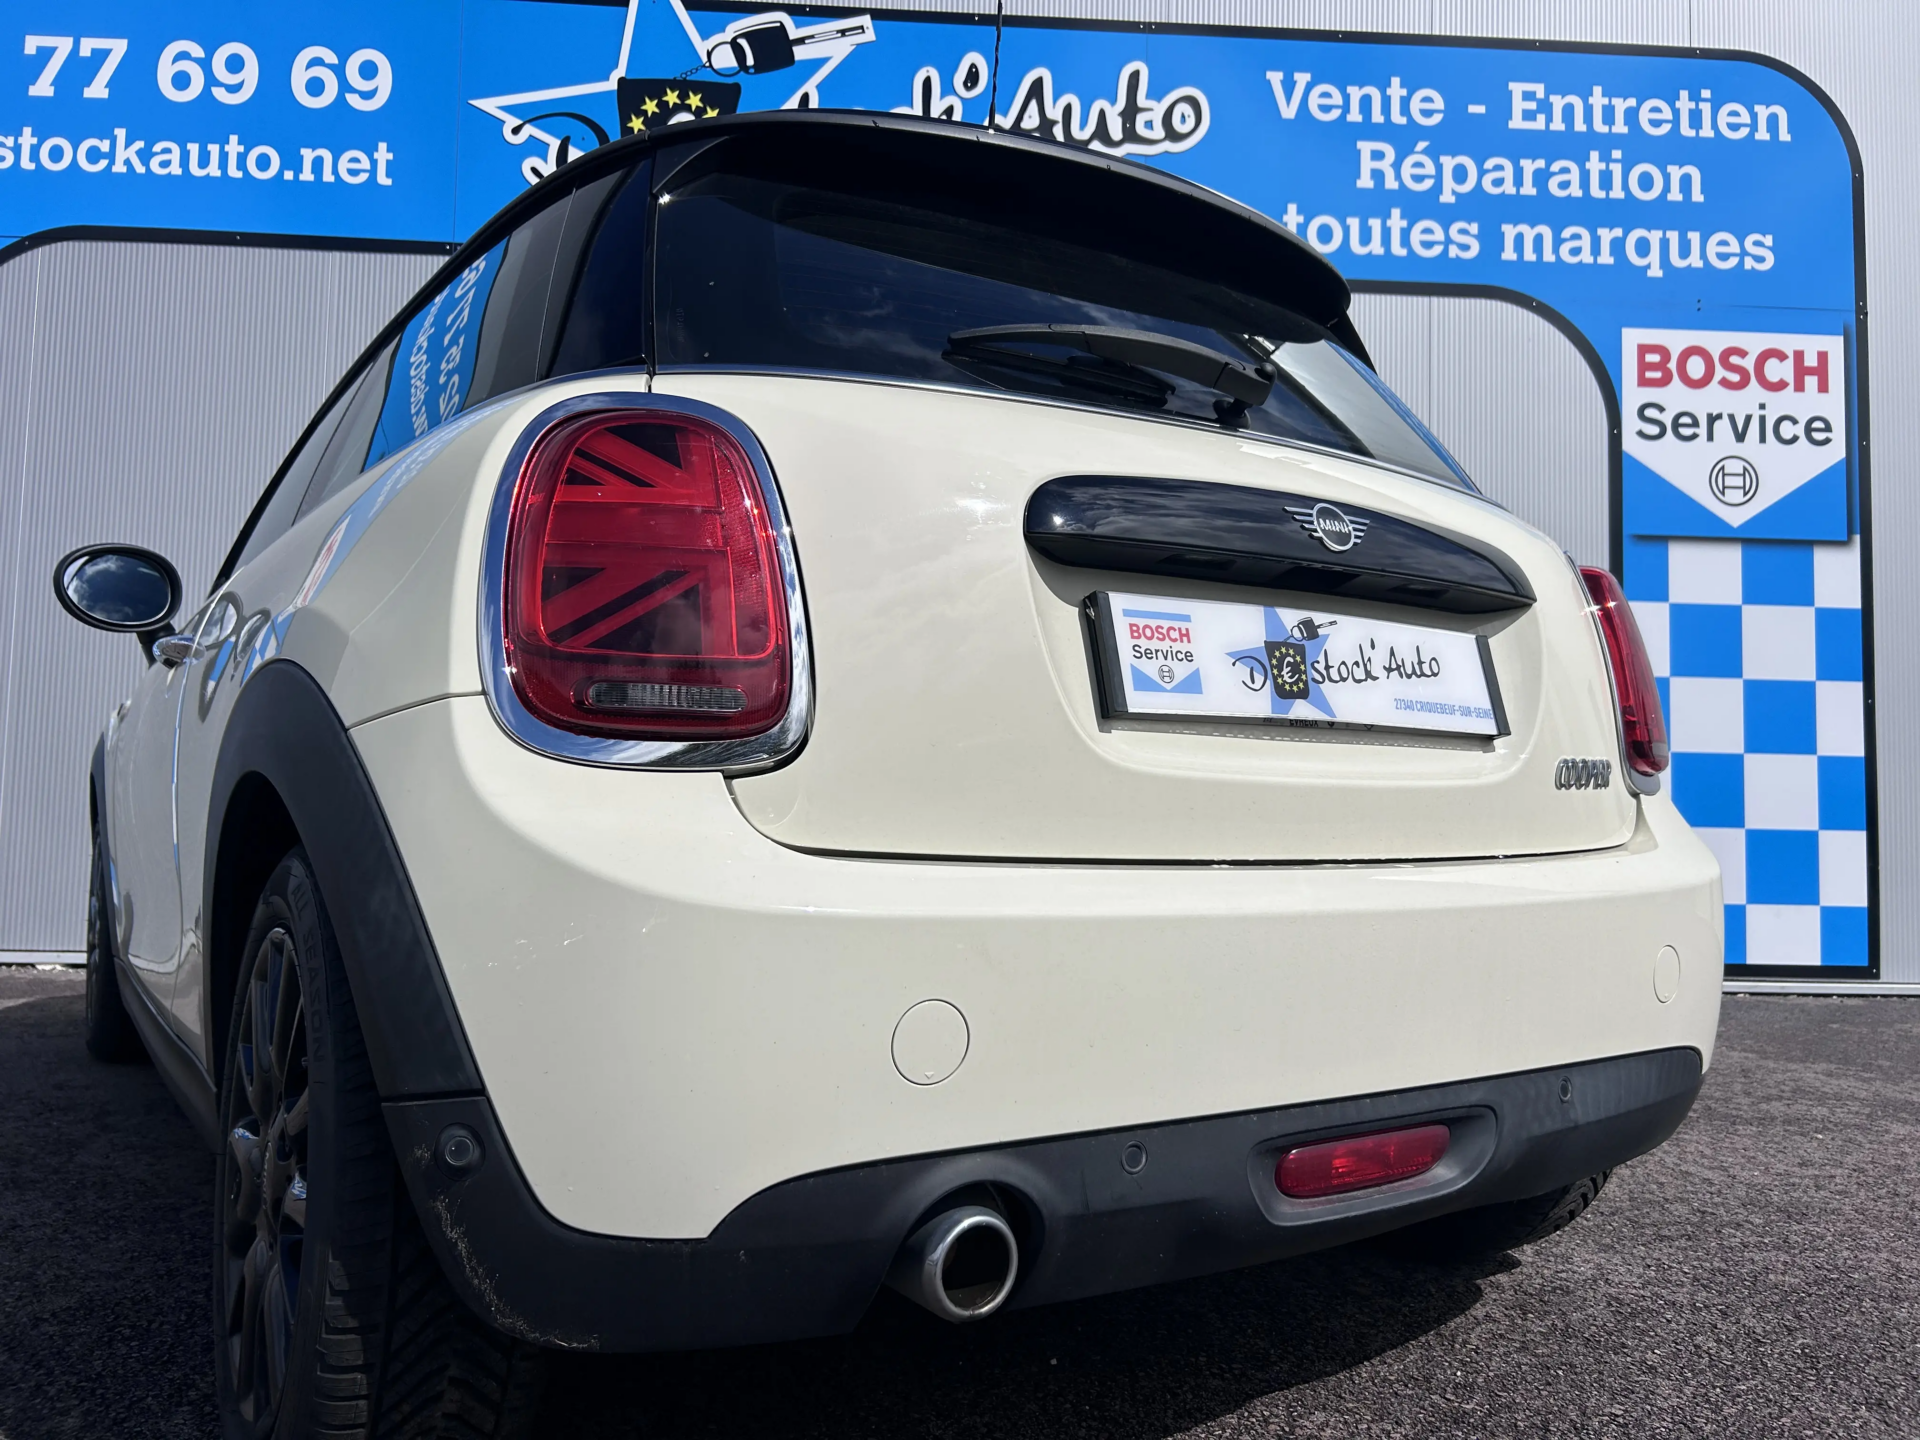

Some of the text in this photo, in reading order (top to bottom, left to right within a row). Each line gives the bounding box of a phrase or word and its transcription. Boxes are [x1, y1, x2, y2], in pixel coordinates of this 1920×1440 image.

[23, 34, 393, 112] 77 69 69
[1265, 70, 1445, 127] Vente
[1507, 81, 1792, 142] Entretien
[1355, 140, 1705, 204] Réparation
[1283, 202, 1775, 278] toutes marques
[1637, 343, 1829, 393] BOSCH
[1636, 402, 1833, 447] Service
[1318, 518, 1349, 534] MINI
[1129, 622, 1191, 644] BOSCH
[1132, 644, 1194, 663] Service
[1393, 698, 1414, 711] 27340
[1554, 757, 1612, 791] COOPER
